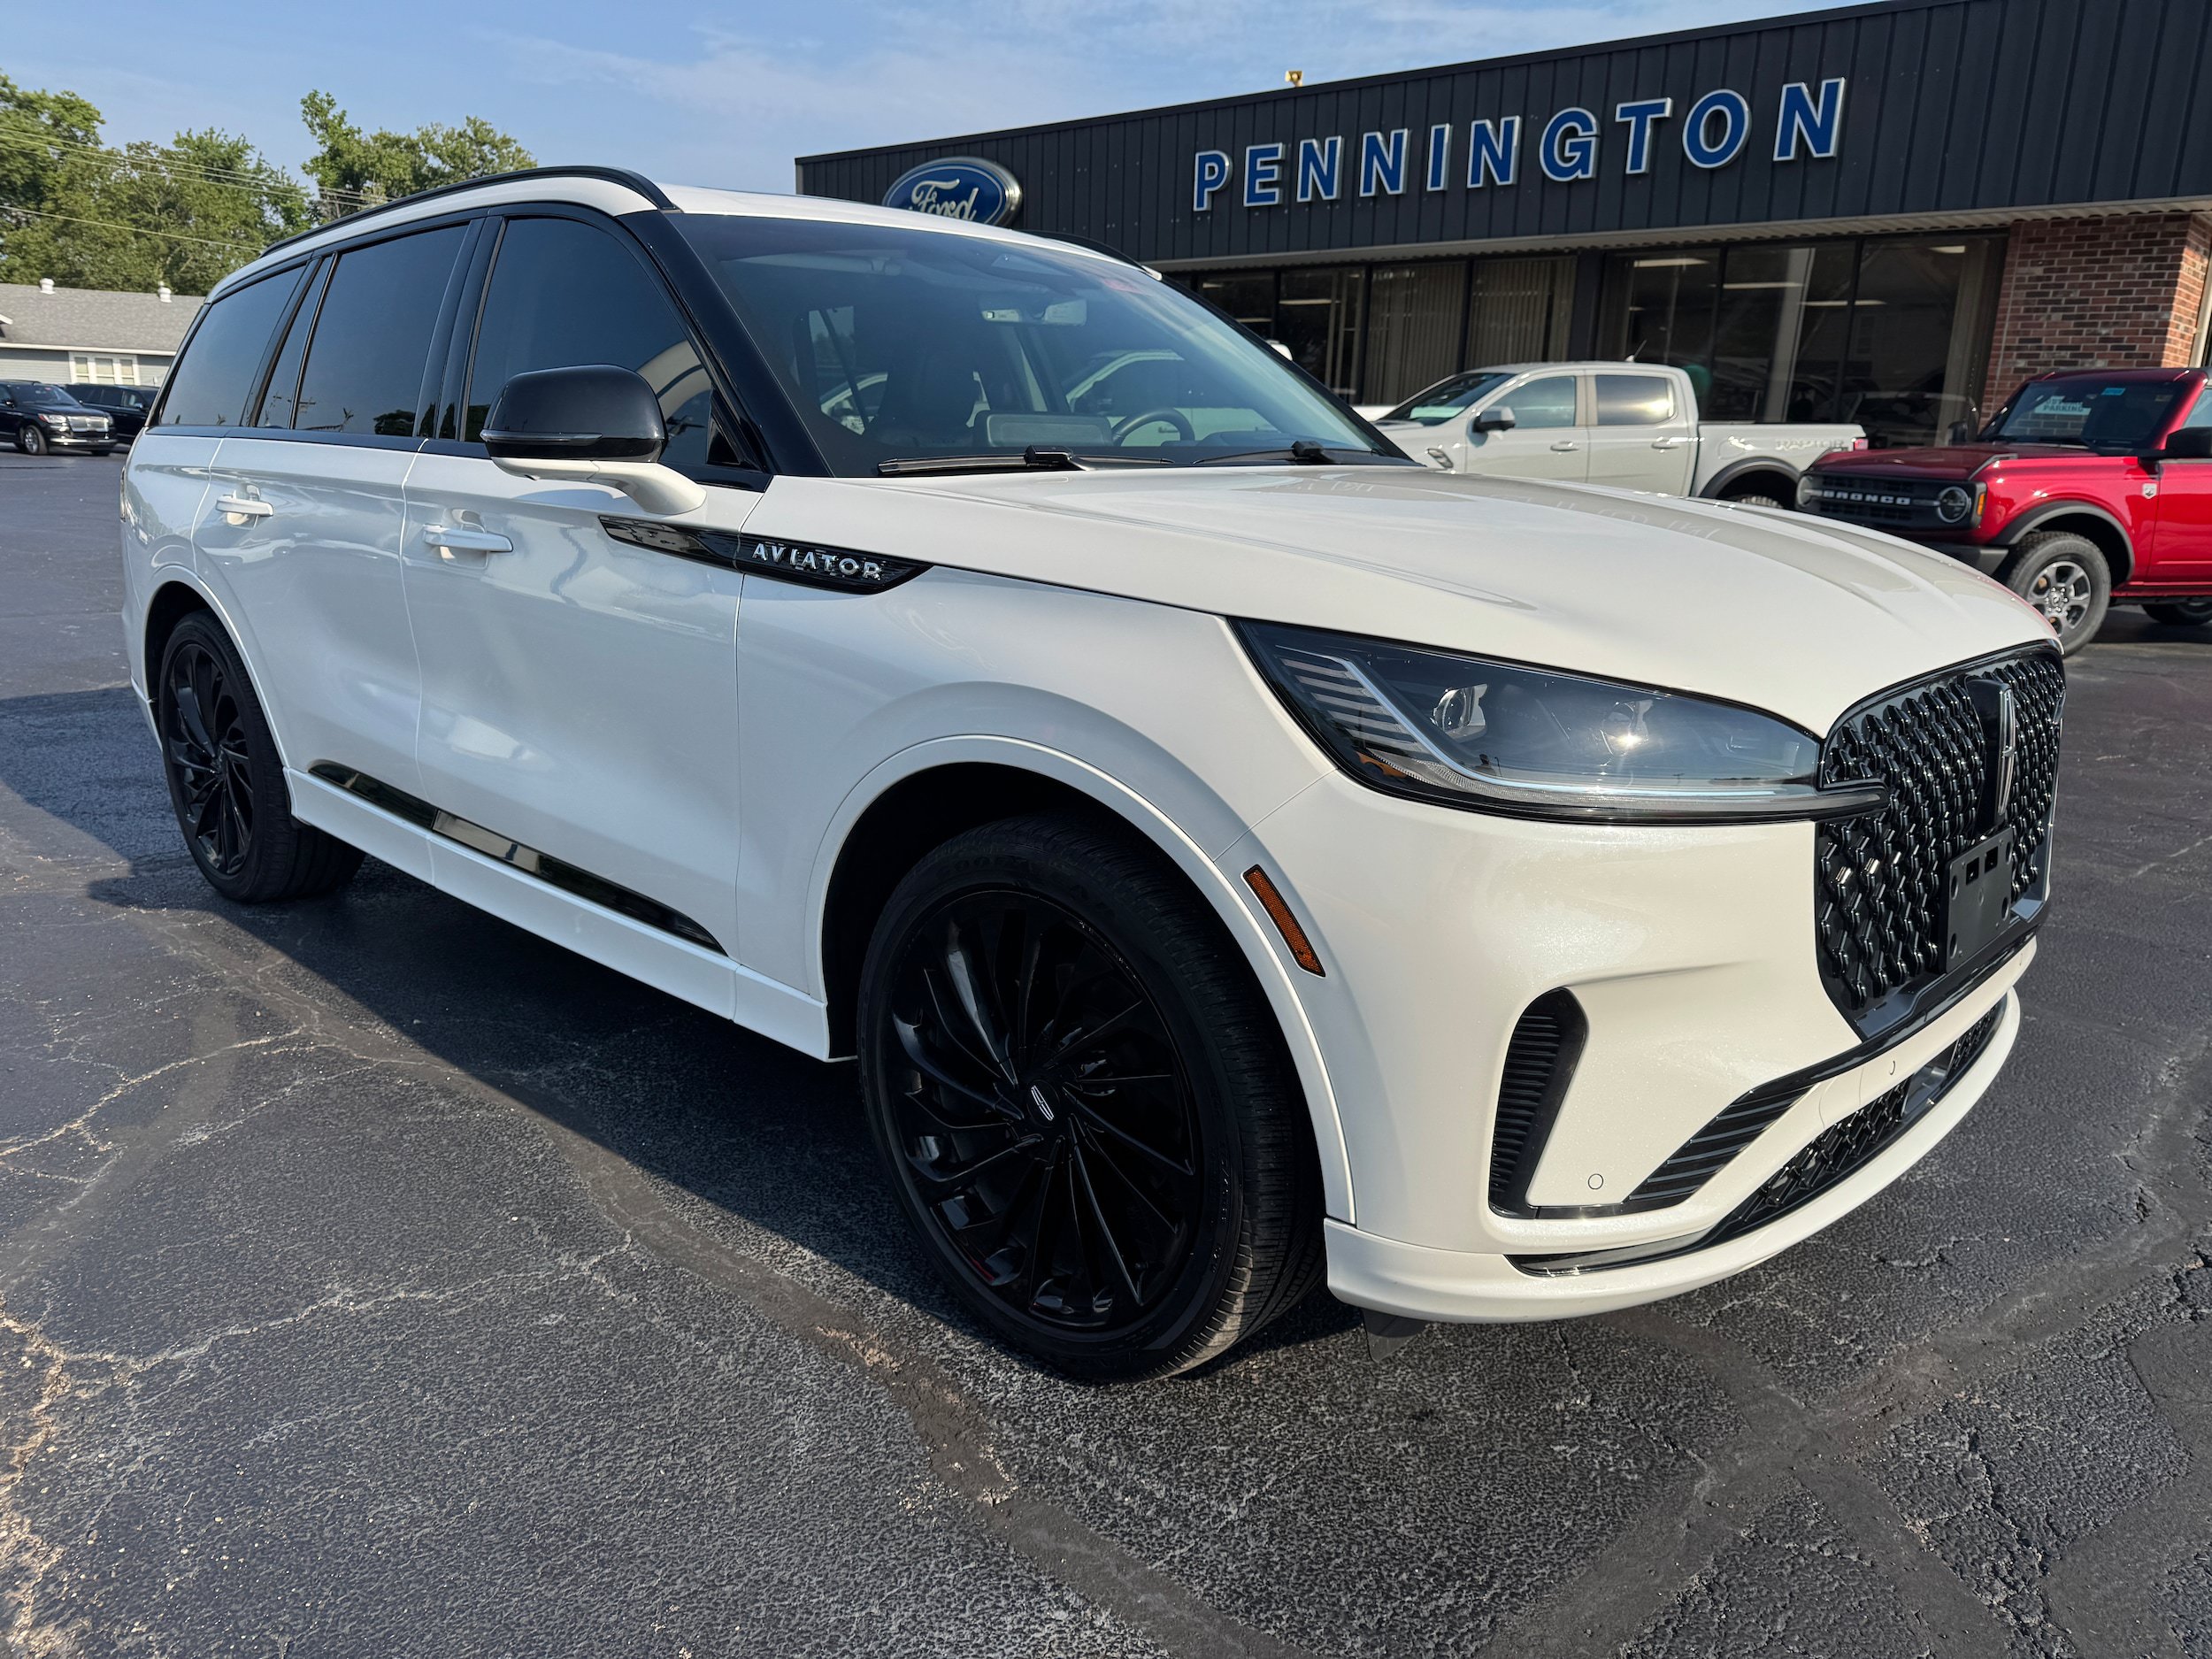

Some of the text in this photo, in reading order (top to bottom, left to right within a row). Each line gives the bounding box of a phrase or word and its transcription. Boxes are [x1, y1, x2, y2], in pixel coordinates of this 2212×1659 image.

[1193, 77, 1846, 211] PENNINGTON
[910, 179, 979, 220] Ford
[1775, 438, 1844, 451] RAPTOR
[1824, 490, 1911, 505] BRONCO
[752, 542, 883, 580] AVIATOR
